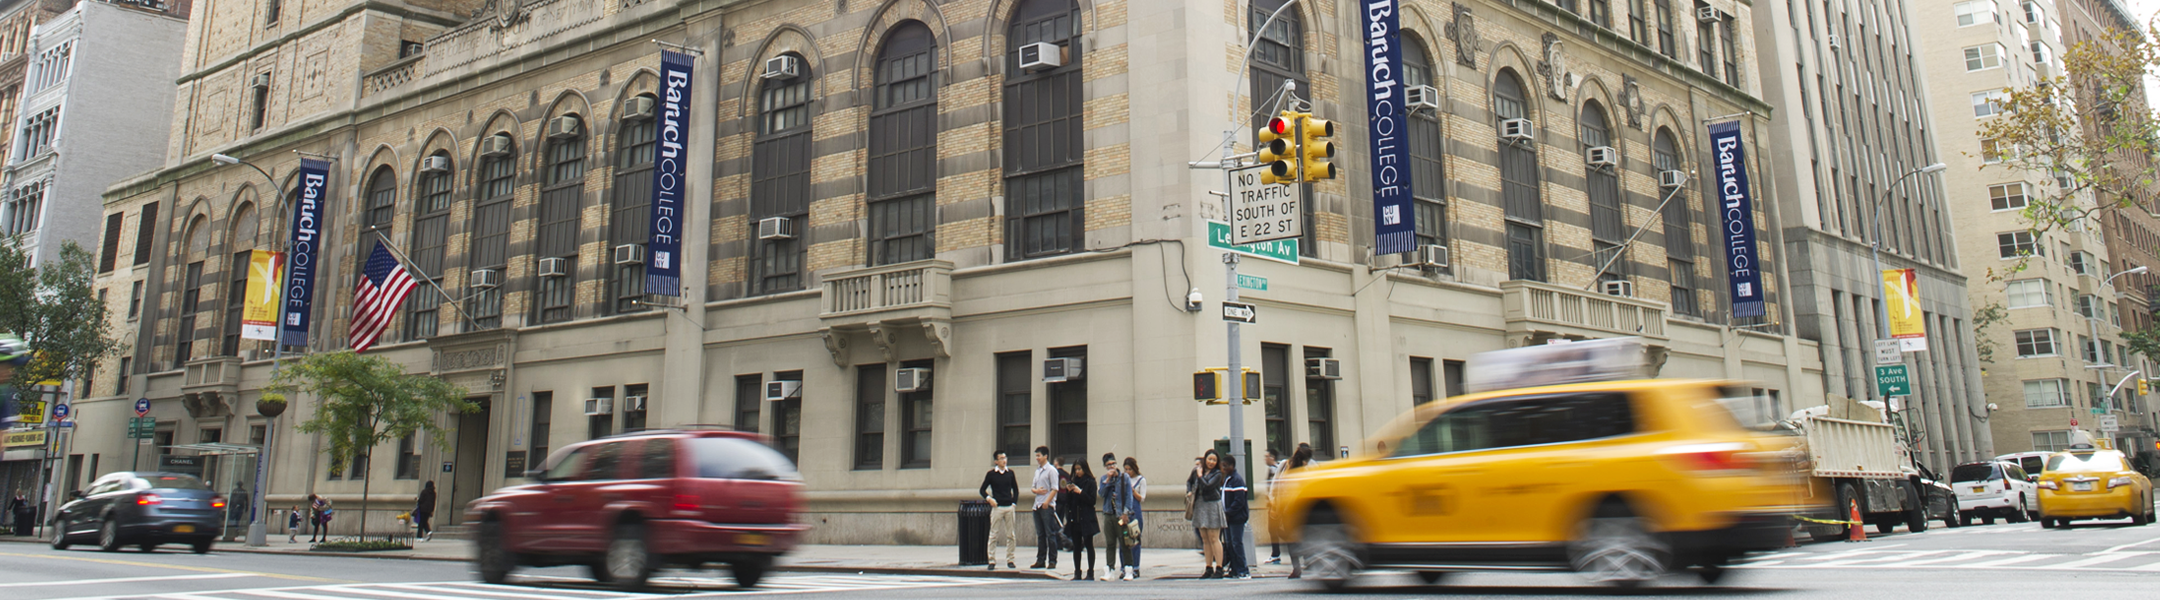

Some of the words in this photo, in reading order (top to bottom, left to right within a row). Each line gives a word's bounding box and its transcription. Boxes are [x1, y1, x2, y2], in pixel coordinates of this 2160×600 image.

[1238, 173, 1254, 187] NO
[1240, 184, 1291, 203] TRAFFIC
[1236, 204, 1275, 221] SOUTH
[1281, 201, 1296, 215] OF
[1240, 225, 1248, 238] E
[1254, 222, 1271, 236] 22
[1278, 219, 1293, 233] ST
[1277, 241, 1291, 256] Av
[1227, 307, 1237, 316] ONE
[1888, 367, 1903, 375] Ave
[1879, 376, 1906, 384] SOUTH
